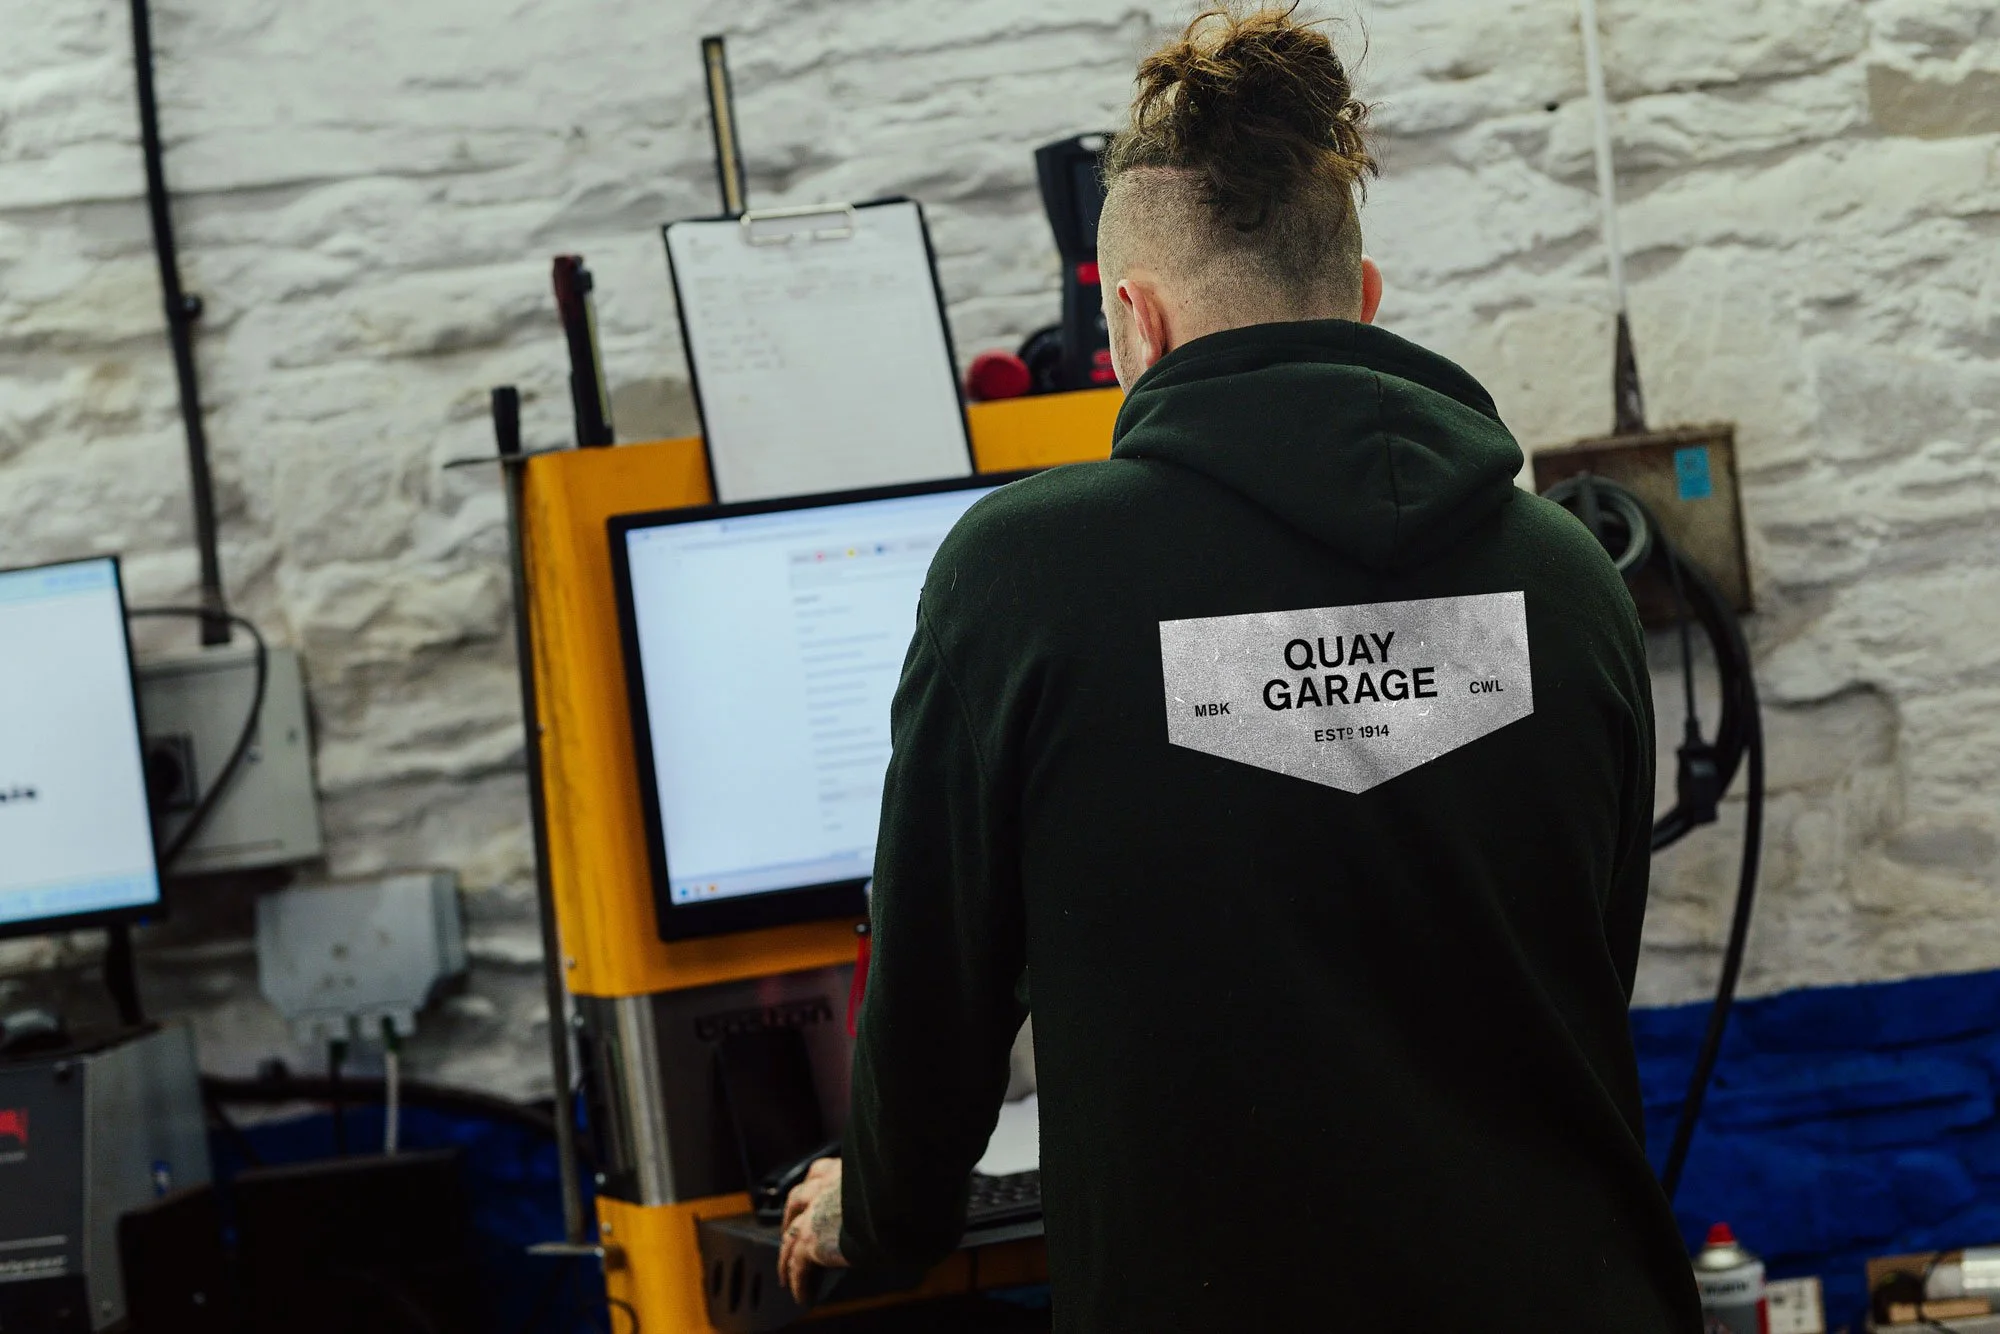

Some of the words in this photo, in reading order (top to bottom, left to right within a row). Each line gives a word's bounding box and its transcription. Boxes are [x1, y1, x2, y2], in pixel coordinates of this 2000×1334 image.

[1283, 631, 1395, 671] QUAY
[1262, 666, 1438, 711] GARAGE
[1468, 680, 1504, 695] CWL
[1194, 702, 1231, 717] MBK
[1358, 724, 1390, 739] 1914
